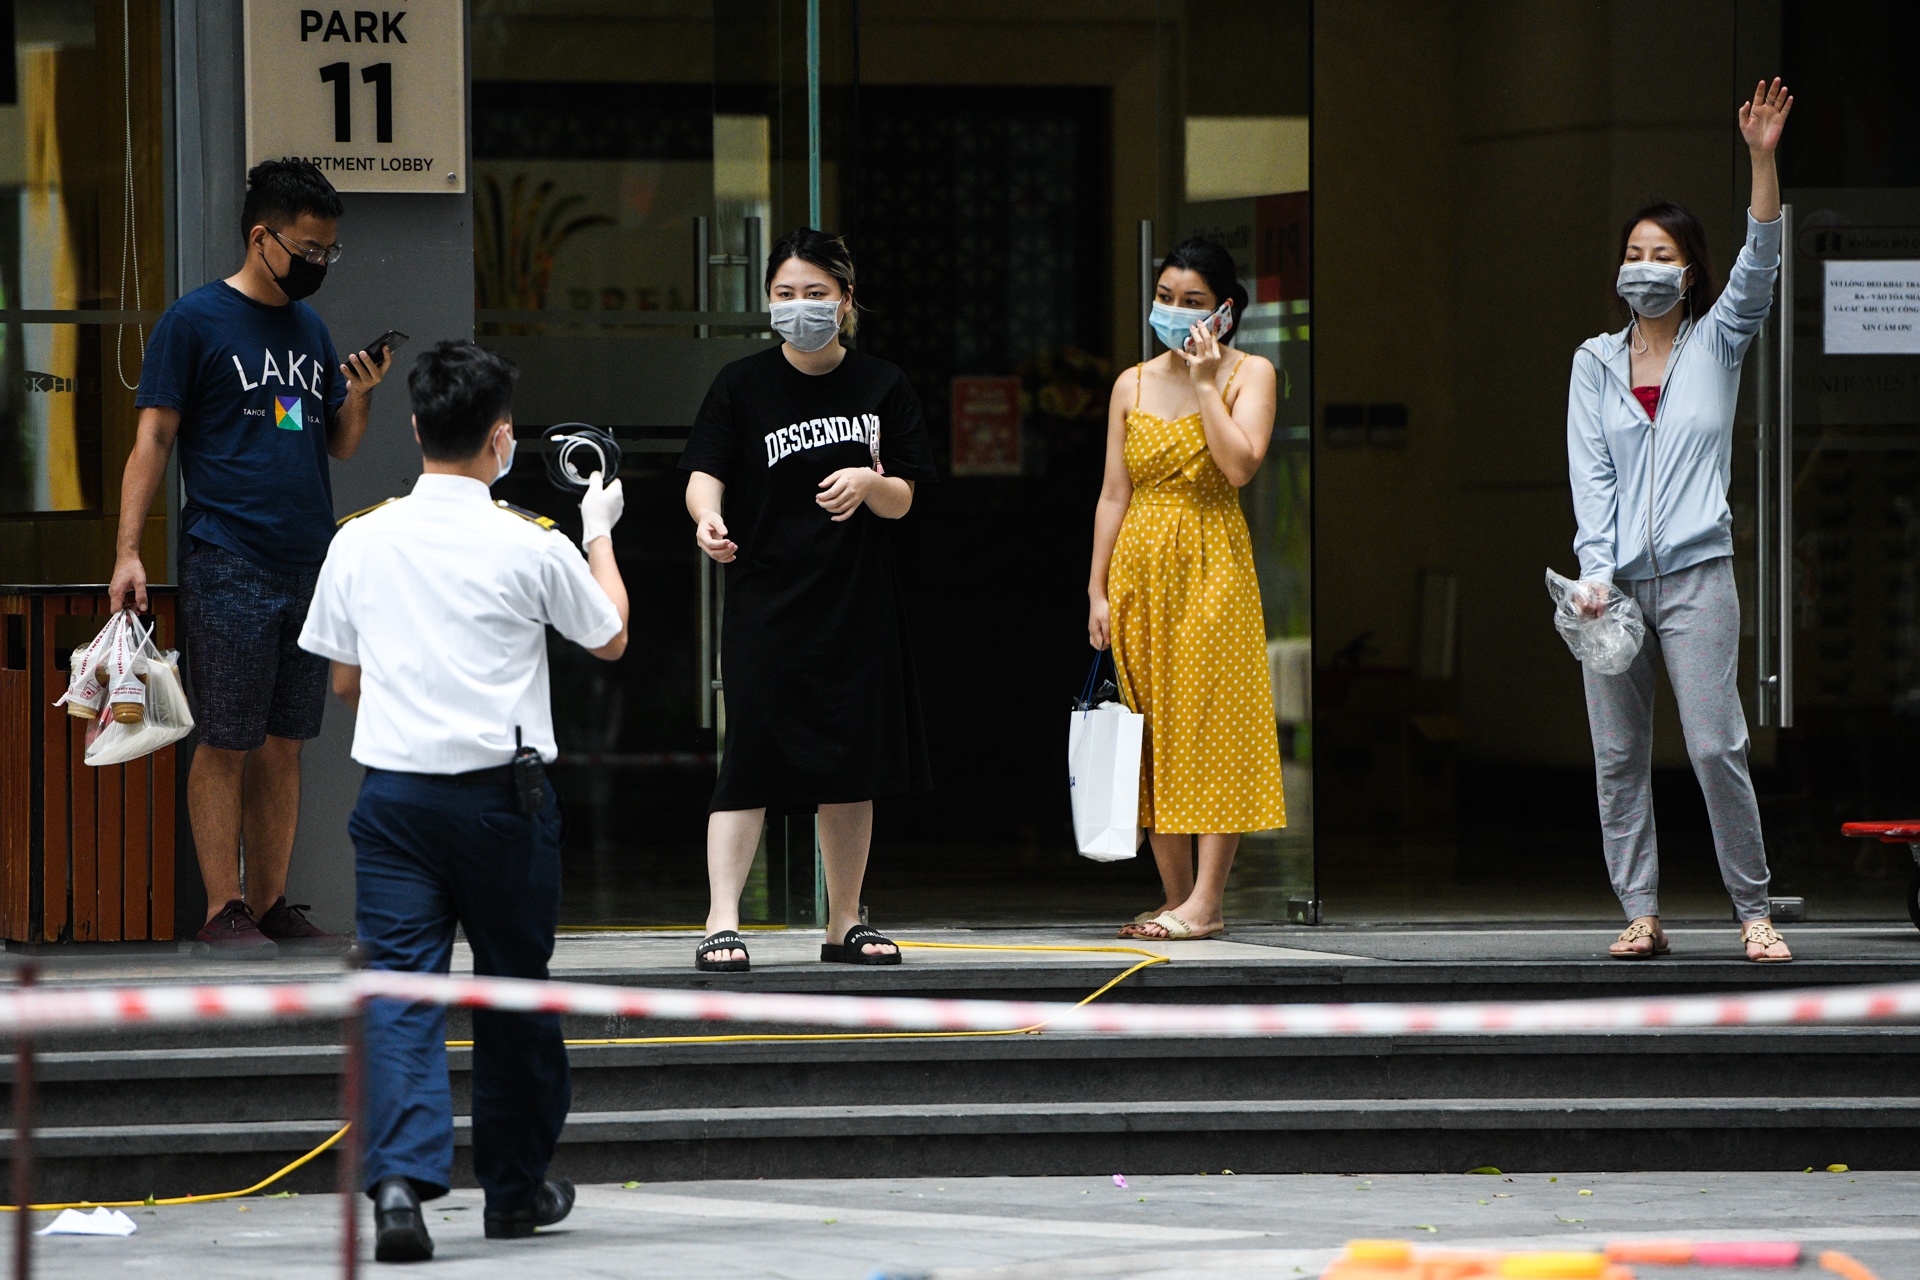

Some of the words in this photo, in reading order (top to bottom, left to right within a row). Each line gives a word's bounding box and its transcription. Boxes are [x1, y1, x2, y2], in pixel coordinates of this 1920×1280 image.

[300, 9, 408, 44] PARK
[318, 61, 393, 143] 11
[381, 157, 434, 172] LOBBY
[232, 347, 324, 401] LAKE
[243, 408, 266, 417] TAHOE
[764, 413, 874, 468] DESCENDAN
[699, 936, 745, 950] BALENCIA
